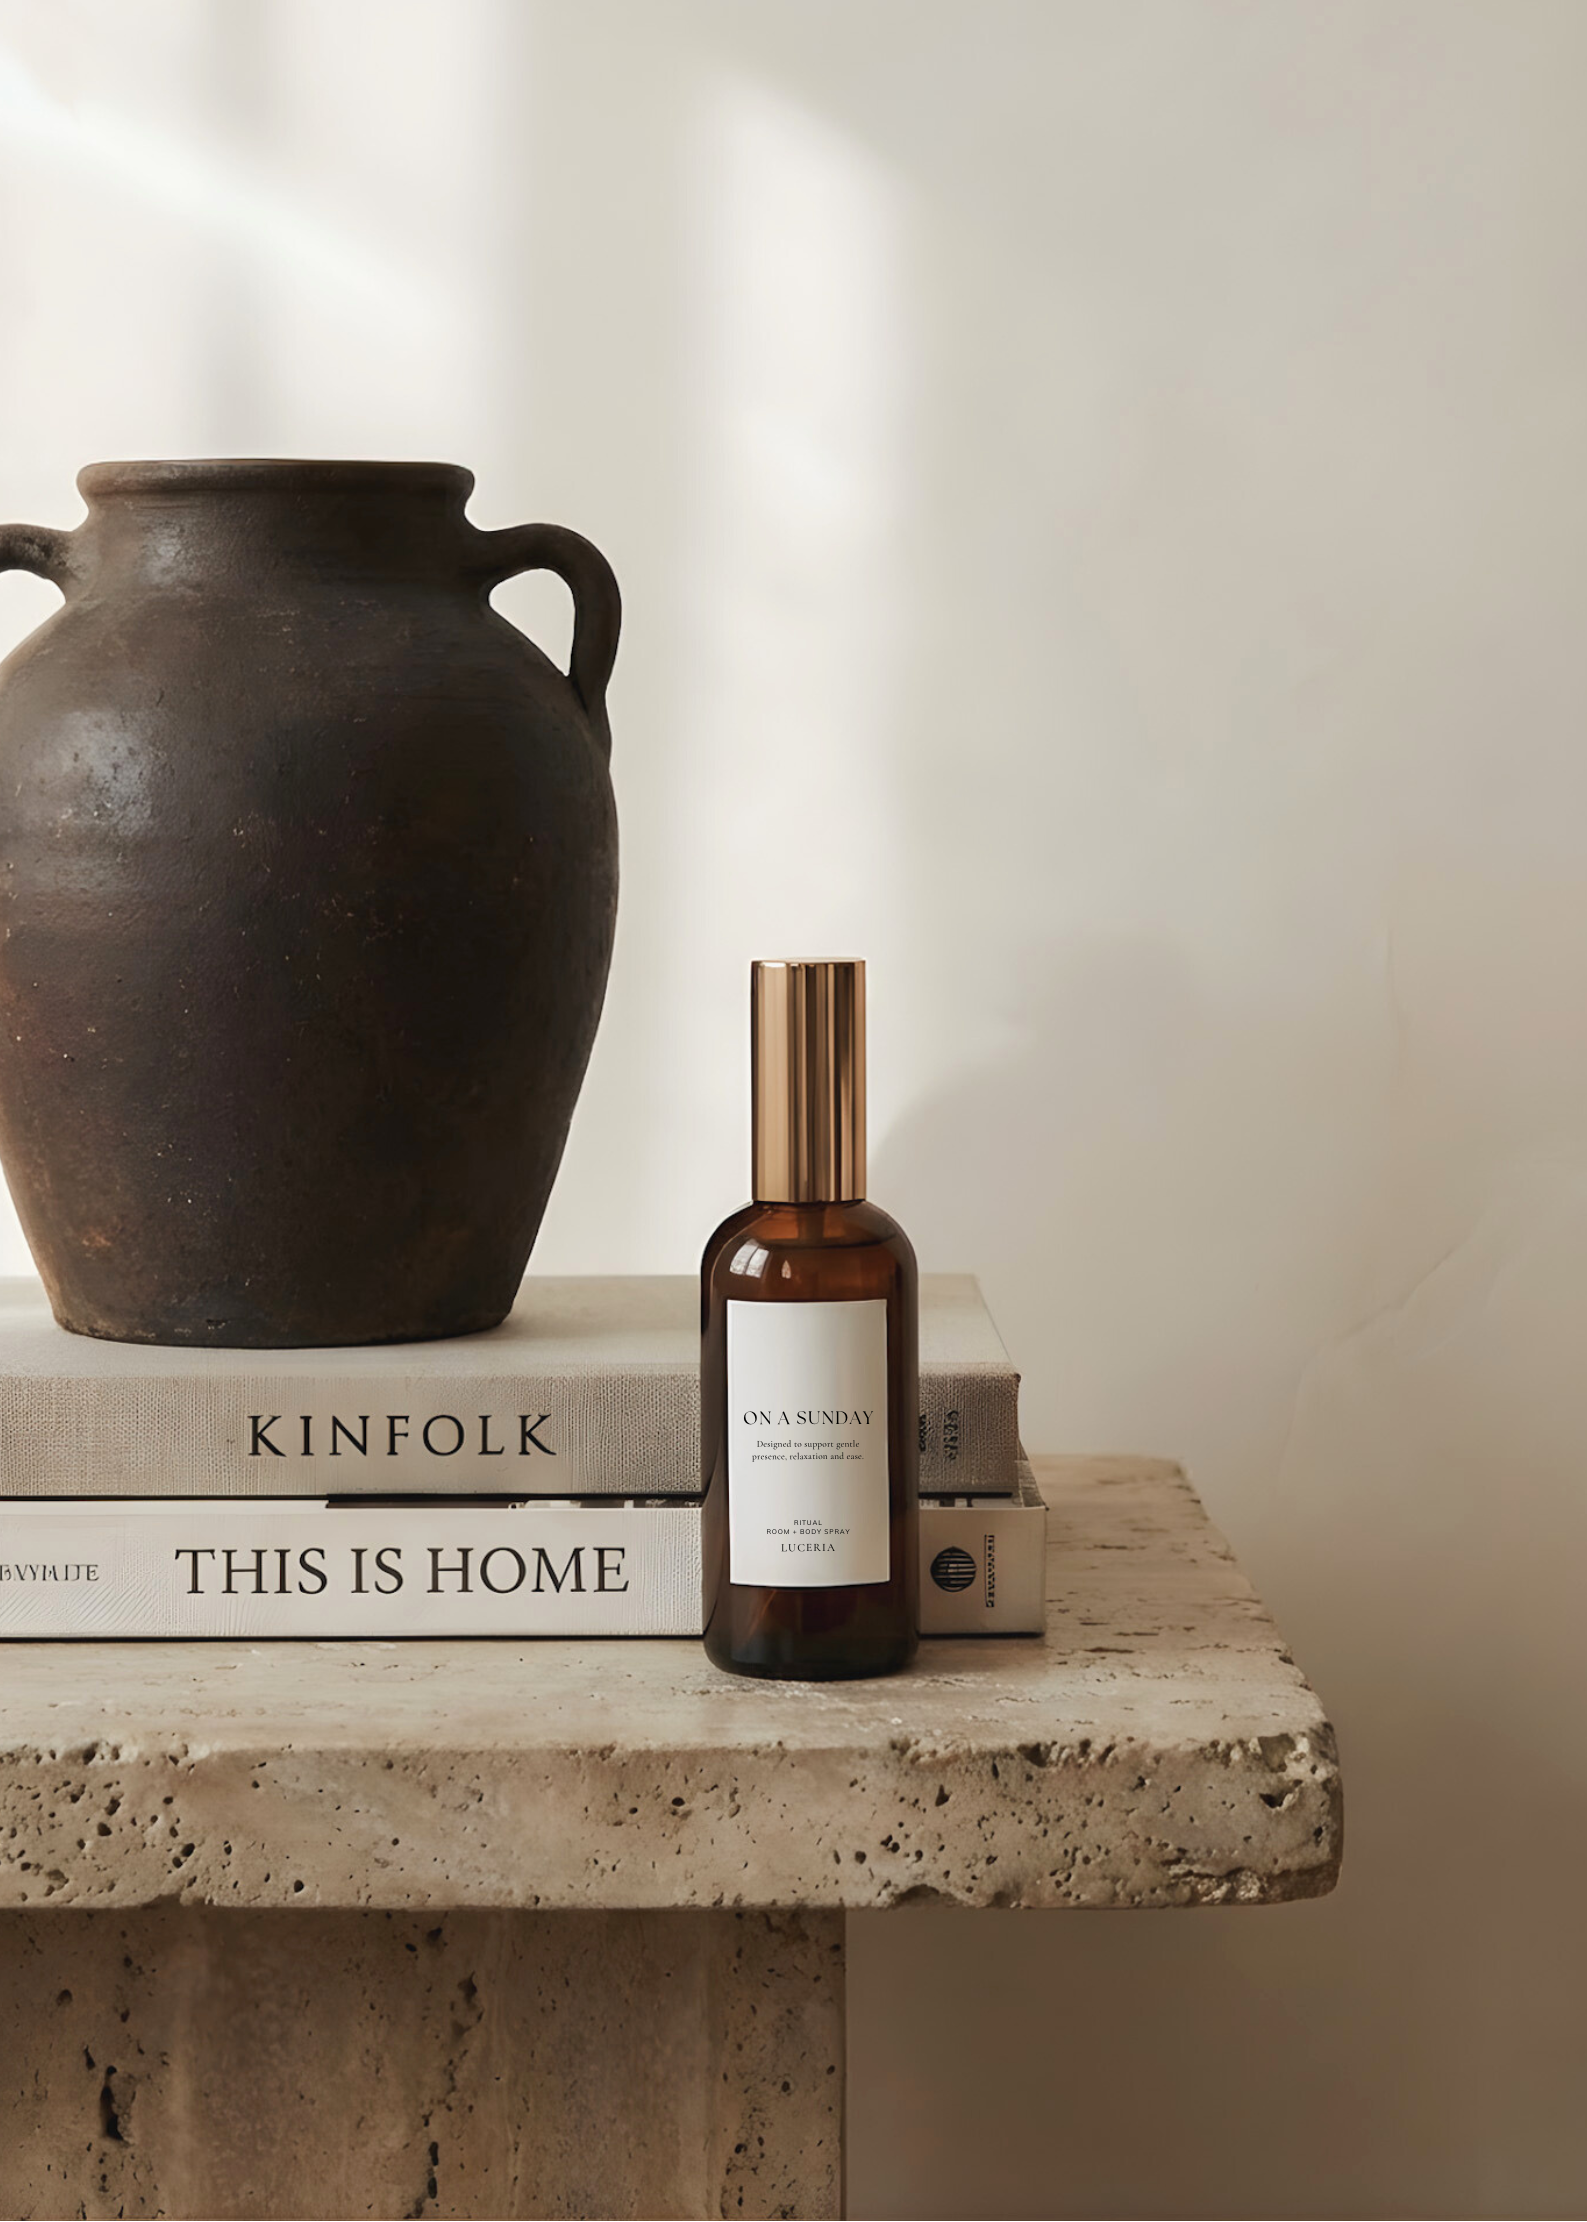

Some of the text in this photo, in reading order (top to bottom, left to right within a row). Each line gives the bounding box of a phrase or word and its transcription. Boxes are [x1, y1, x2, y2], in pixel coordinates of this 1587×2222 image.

[743, 1410, 874, 1425] ON A SUNDAY
[247, 1413, 557, 1457] KINFOLK
[757, 1440, 860, 1450] Designed to support gentle
[752, 1452, 864, 1462] presence, relaxation and ease.
[781, 1543, 836, 1552] LUCERIA
[174, 1546, 631, 1595] THIS IS HOME
